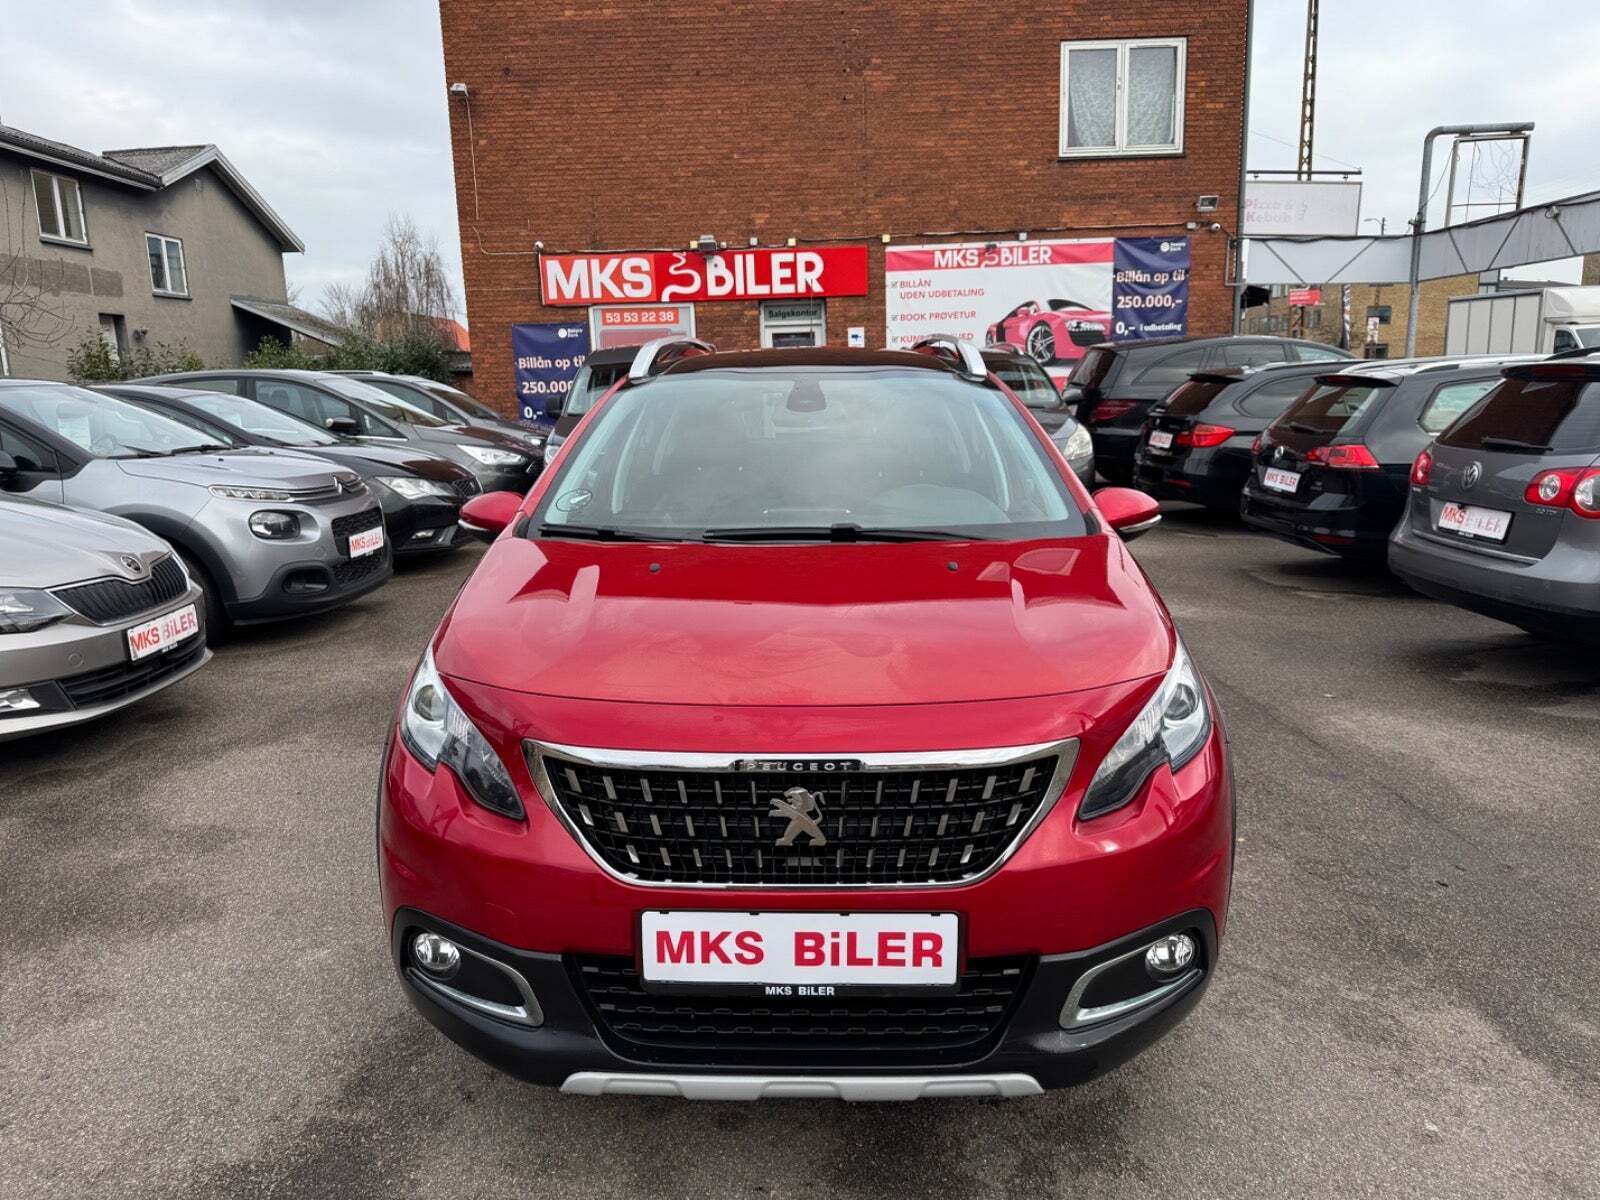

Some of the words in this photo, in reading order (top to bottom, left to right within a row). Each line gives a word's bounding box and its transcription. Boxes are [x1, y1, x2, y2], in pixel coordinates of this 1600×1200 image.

[934, 250, 979, 268] MKS
[1001, 247, 1052, 266] BILER
[545, 257, 651, 300] MKS
[706, 252, 825, 296] BILER
[1116, 270, 1151, 282] Billån
[1153, 272, 1170, 285] op
[1172, 269, 1185, 281] til
[900, 279, 932, 289] BILLÅN
[900, 292, 925, 300] UDEN
[928, 288, 985, 298] UDBETALING
[1116, 295, 1183, 309] 250.000,-
[623, 312, 638, 323] 53
[641, 312, 656, 322] 22
[900, 313, 927, 321] BOOK
[929, 311, 977, 320] PRØVETUR
[518, 356, 552, 369] Billån
[554, 359, 571, 370] op
[1442, 506, 1466, 524] MKS
[130, 627, 160, 653] MKS
[746, 762, 853, 772] PEUGEOT
[656, 931, 764, 965] MKS
[764, 986, 793, 997] MKS
